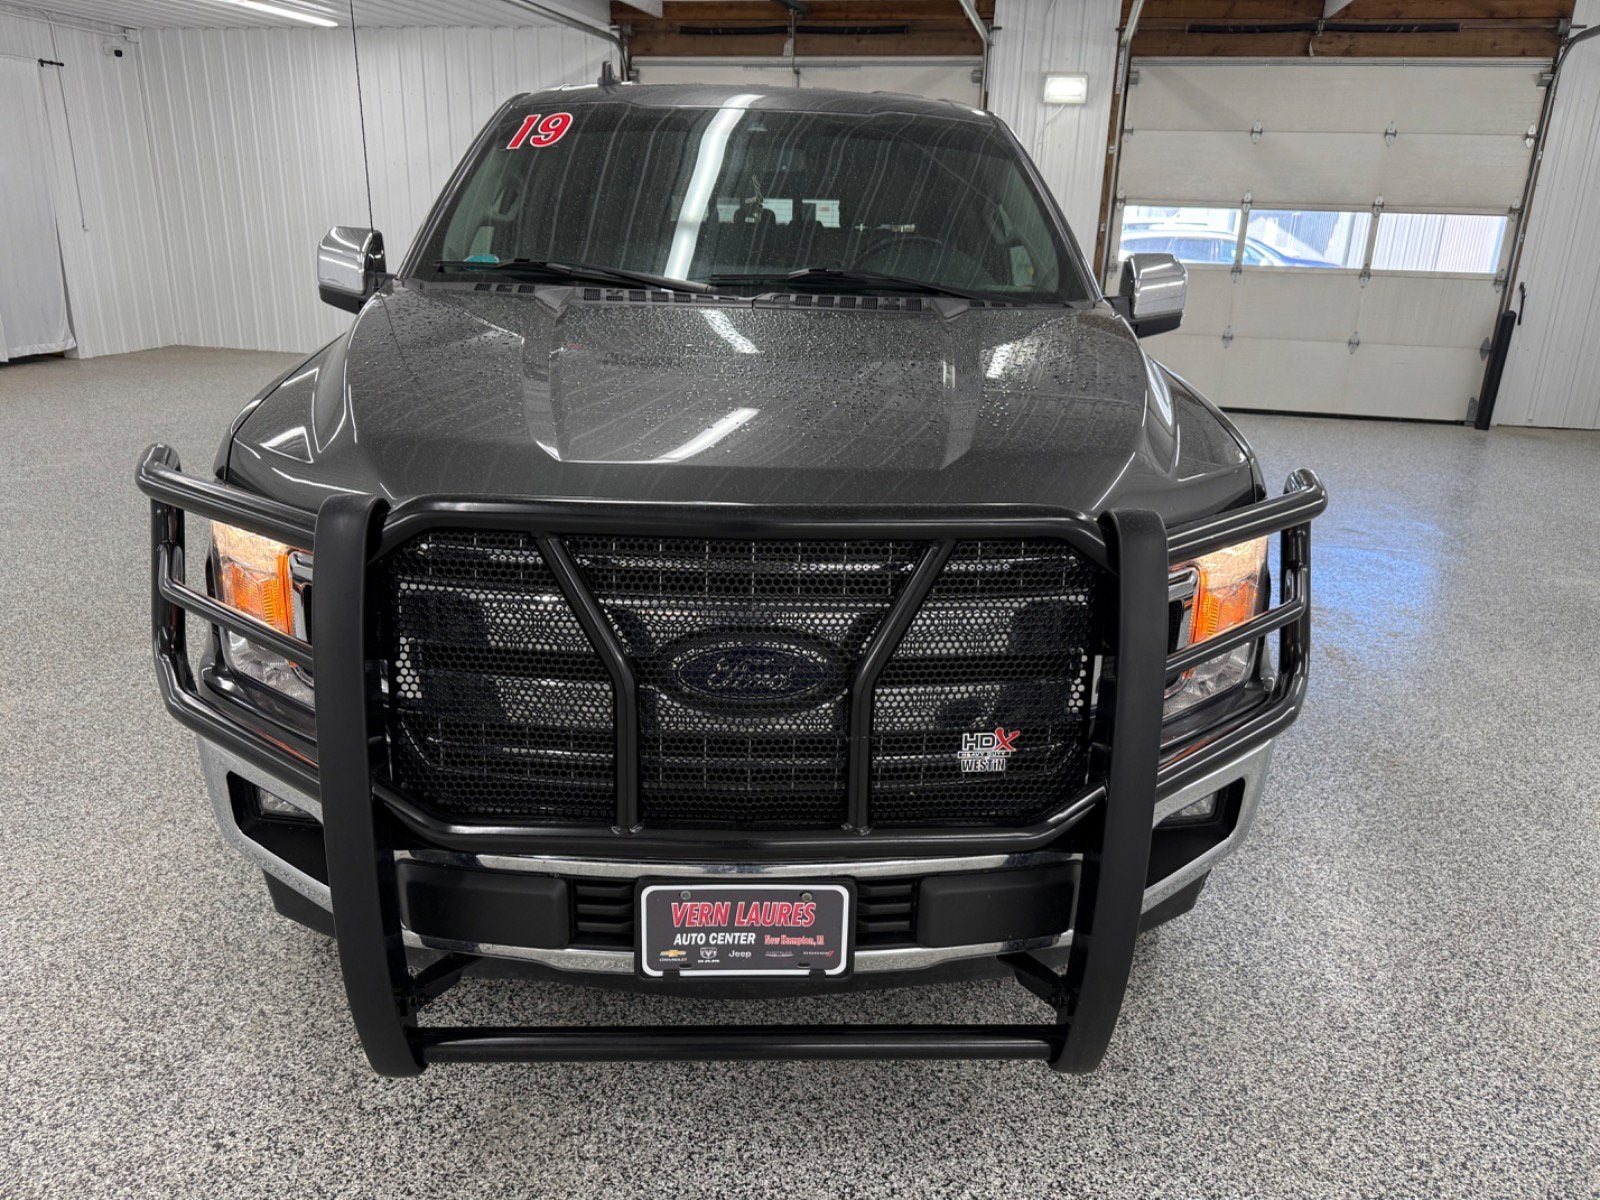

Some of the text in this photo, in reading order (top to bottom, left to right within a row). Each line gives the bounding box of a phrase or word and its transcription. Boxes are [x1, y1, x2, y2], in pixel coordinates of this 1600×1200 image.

[506, 112, 573, 150] 19
[962, 727, 1020, 751] HDX
[671, 901, 816, 927] VERN LAURES
[673, 932, 756, 945] AUTO CENTER
[764, 934, 780, 945] New
[781, 934, 816, 947] Hampton,
[728, 949, 752, 958] Jeep
